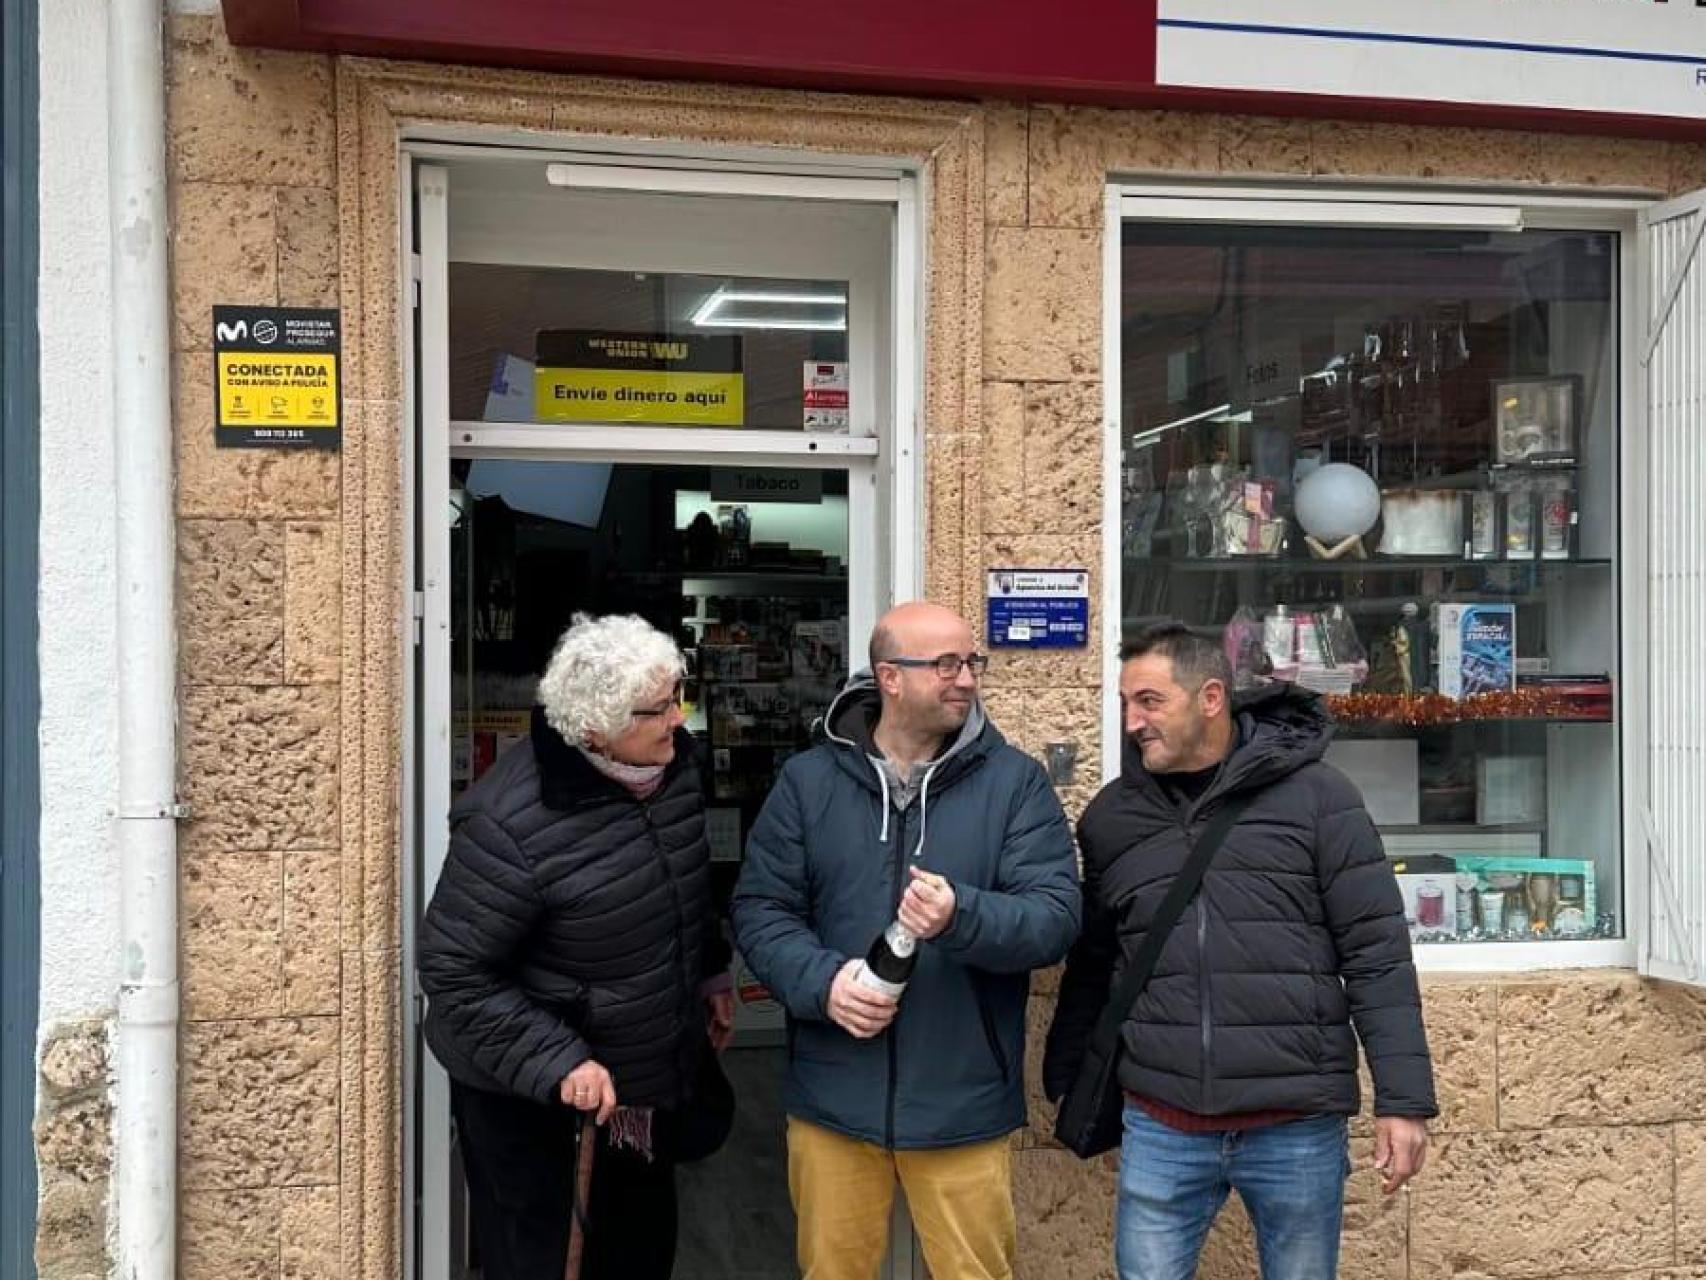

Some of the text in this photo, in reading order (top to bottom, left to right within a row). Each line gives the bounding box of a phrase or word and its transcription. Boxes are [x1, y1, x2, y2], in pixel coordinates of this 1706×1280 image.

[589, 338, 689, 360] WESTERN WU
[607, 348, 648, 358] UNION
[227, 363, 328, 377] CONECTADA
[227, 378, 249, 387] CON
[251, 378, 280, 387] AVISO
[282, 379, 289, 387] A
[613, 385, 677, 403] dinero
[735, 473, 801, 490] Tabaco
